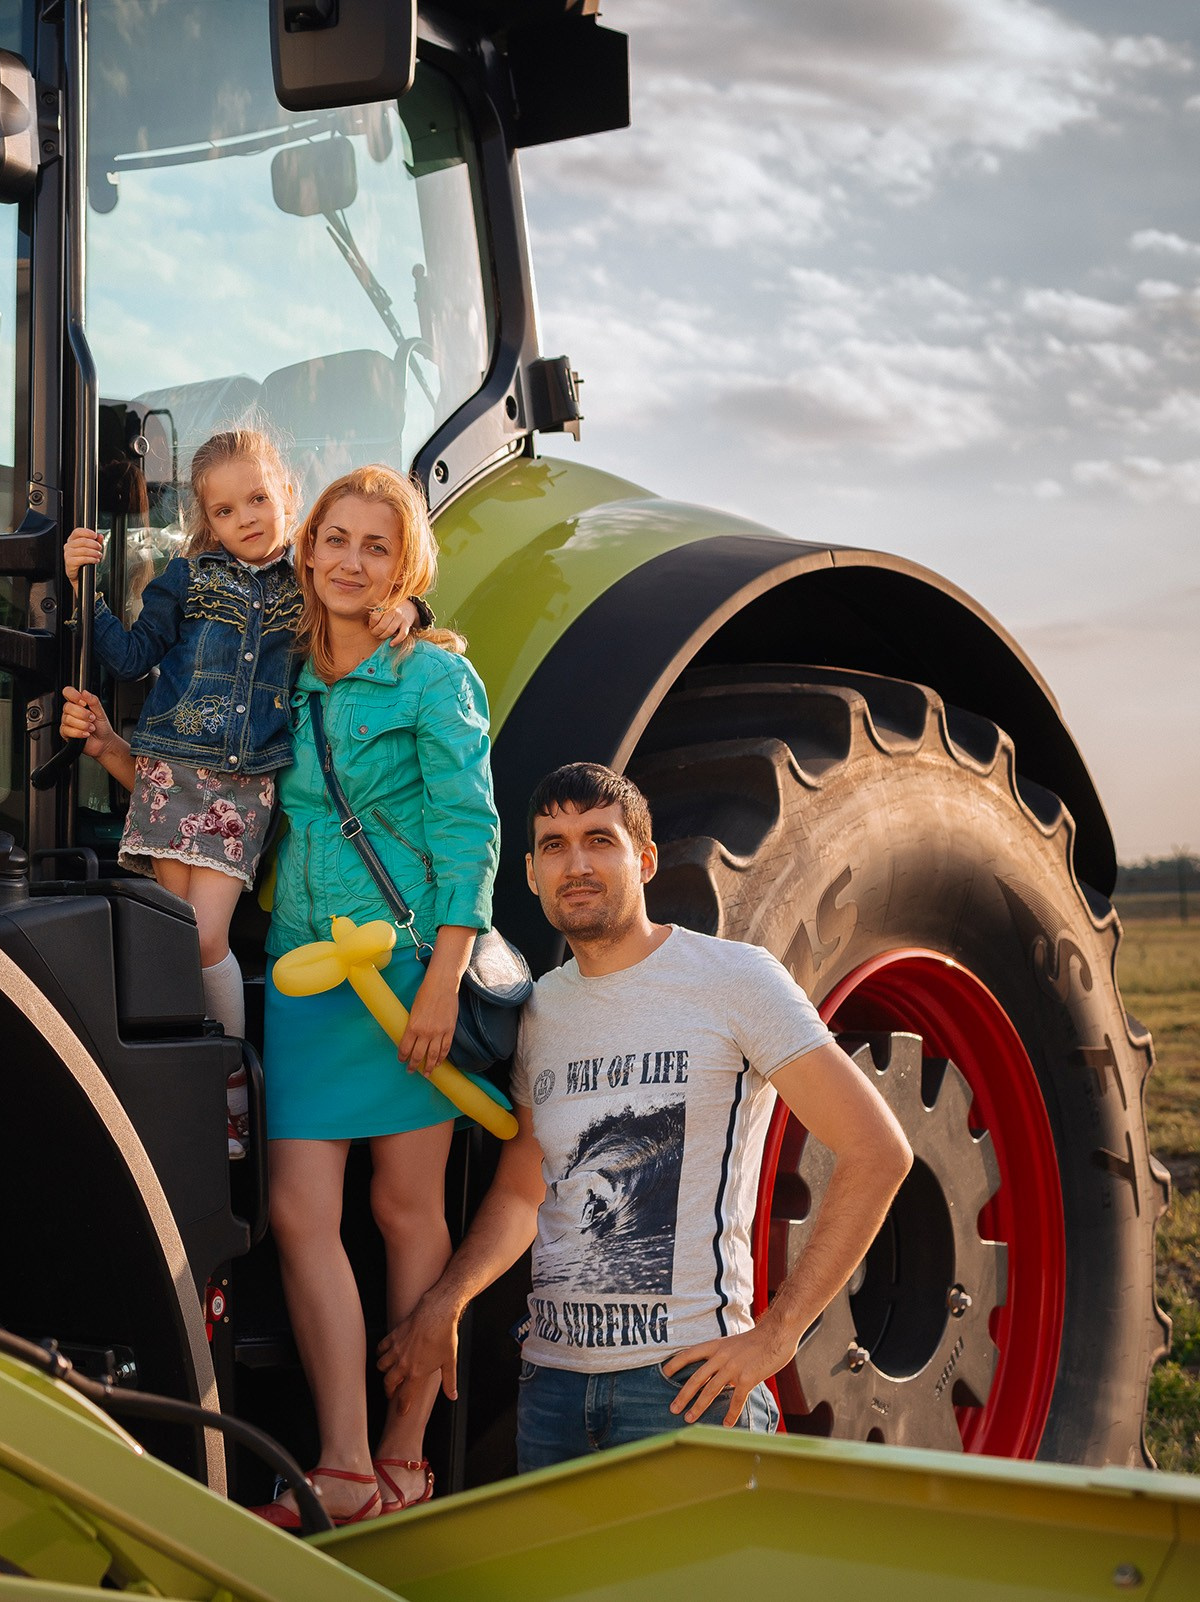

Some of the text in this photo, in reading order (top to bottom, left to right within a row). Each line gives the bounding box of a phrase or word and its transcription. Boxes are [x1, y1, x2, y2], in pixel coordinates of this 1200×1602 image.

[566, 1050, 689, 1095] WAY OF LIFE
[562, 1301, 669, 1348] SURFING
